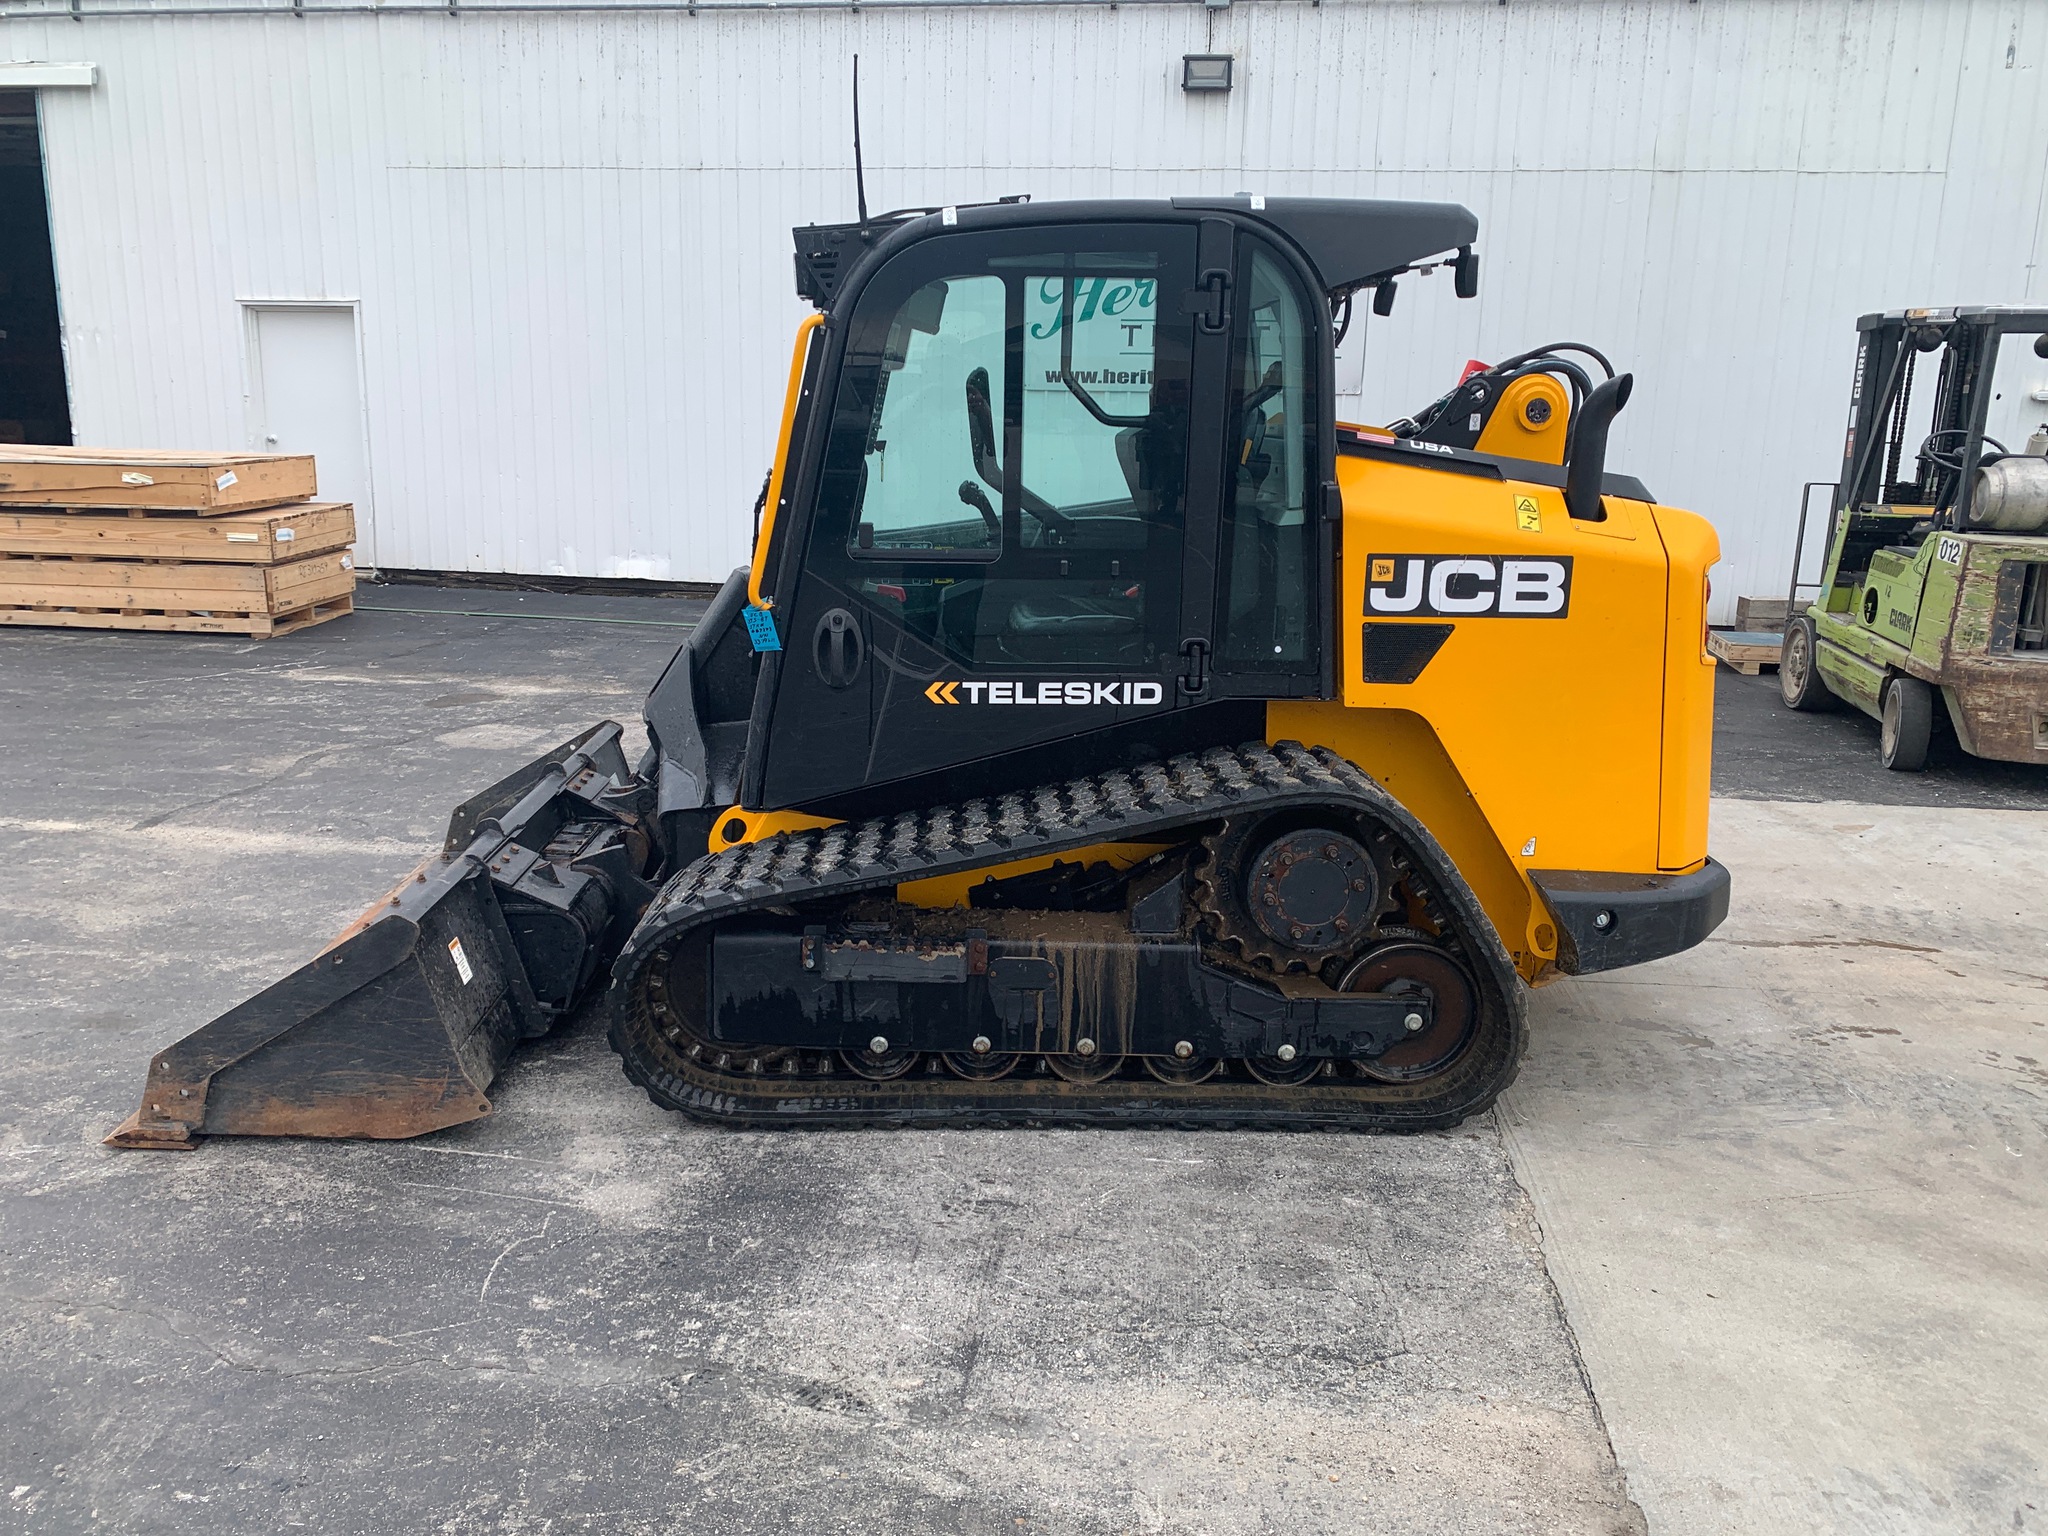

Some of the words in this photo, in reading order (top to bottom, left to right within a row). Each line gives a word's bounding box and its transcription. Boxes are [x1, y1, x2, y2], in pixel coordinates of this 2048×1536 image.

[1853, 345, 1867, 399] CLARK
[1410, 439, 1454, 455] USA
[1939, 539, 1961, 564] 012
[1376, 564, 1392, 577] JCB
[1369, 559, 1566, 613] JCB
[1889, 608, 1914, 633] CLARK
[961, 681, 1163, 705] TELESKID
